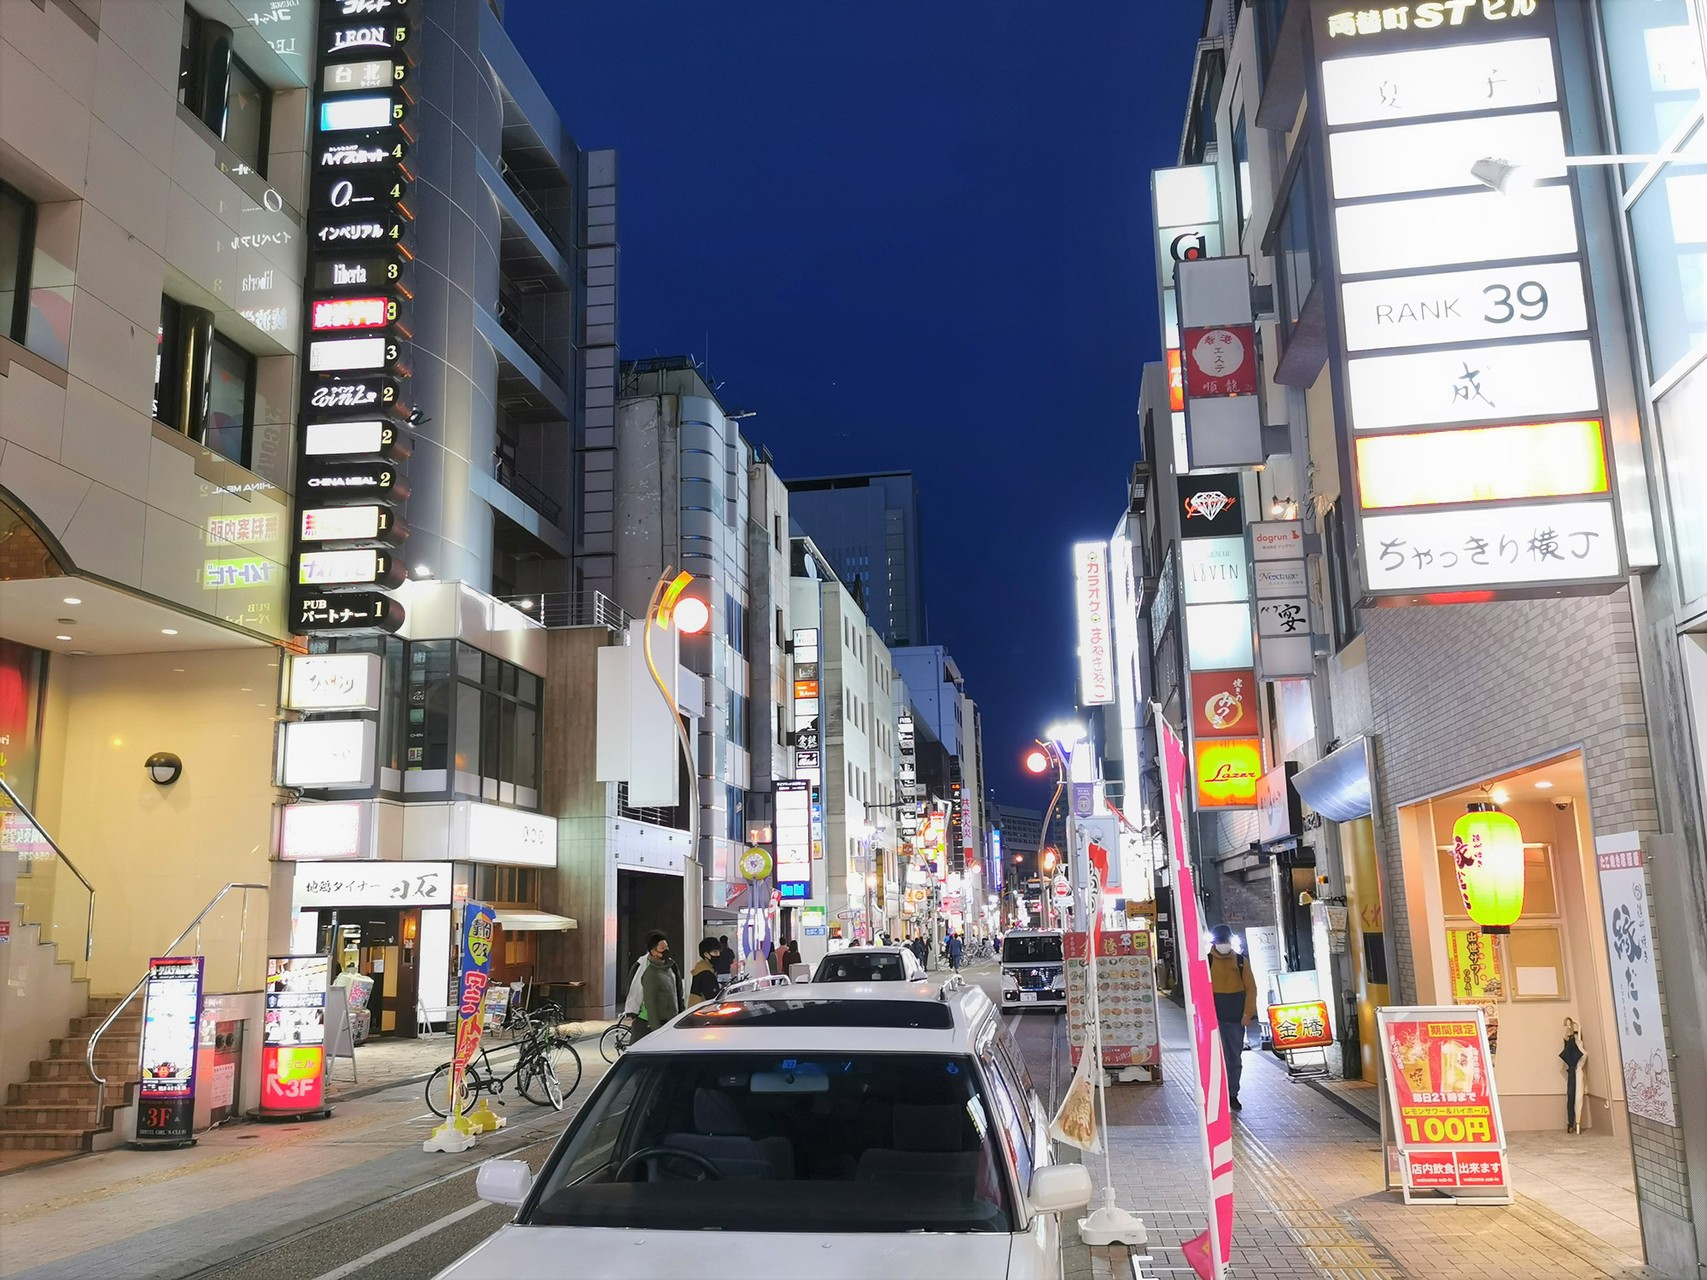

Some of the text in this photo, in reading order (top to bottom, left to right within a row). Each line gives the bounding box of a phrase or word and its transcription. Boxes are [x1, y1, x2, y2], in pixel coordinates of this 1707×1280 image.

[335, 27, 405, 46] LEON 5
[335, 64, 404, 83] 台北 5
[393, 105, 403, 119] 5
[392, 144, 402, 157] 4
[390, 184, 400, 197] 4
[389, 225, 399, 238] 4
[334, 264, 398, 285] liberta 3
[1376, 281, 1549, 325] RANK 39
[386, 345, 397, 360] 3
[1212, 347, 1226, 373] エステ
[383, 387, 394, 401] 2
[382, 430, 392, 444] 2
[380, 472, 391, 486] 2
[379, 514, 387, 530] 1
[1256, 533, 1288, 543] dogrun
[1380, 526, 1599, 572] ちゃっきり横丁
[377, 558, 385, 573] 1
[1087, 562, 1101, 612] カラオケ
[301, 602, 382, 623] パートナー 1
[303, 600, 326, 610] PUB
[1204, 764, 1255, 783] Lazer
[1430, 1024, 1475, 1036] 期間限定
[286, 1079, 313, 1097] 3F
[1412, 1093, 1476, 1103] 毎日21時まで
[147, 1108, 172, 1128] 3F
[1405, 1117, 1492, 1143] 100円
[1411, 1163, 1455, 1176] 店内飲食
[1459, 1162, 1501, 1174] 出来ます
